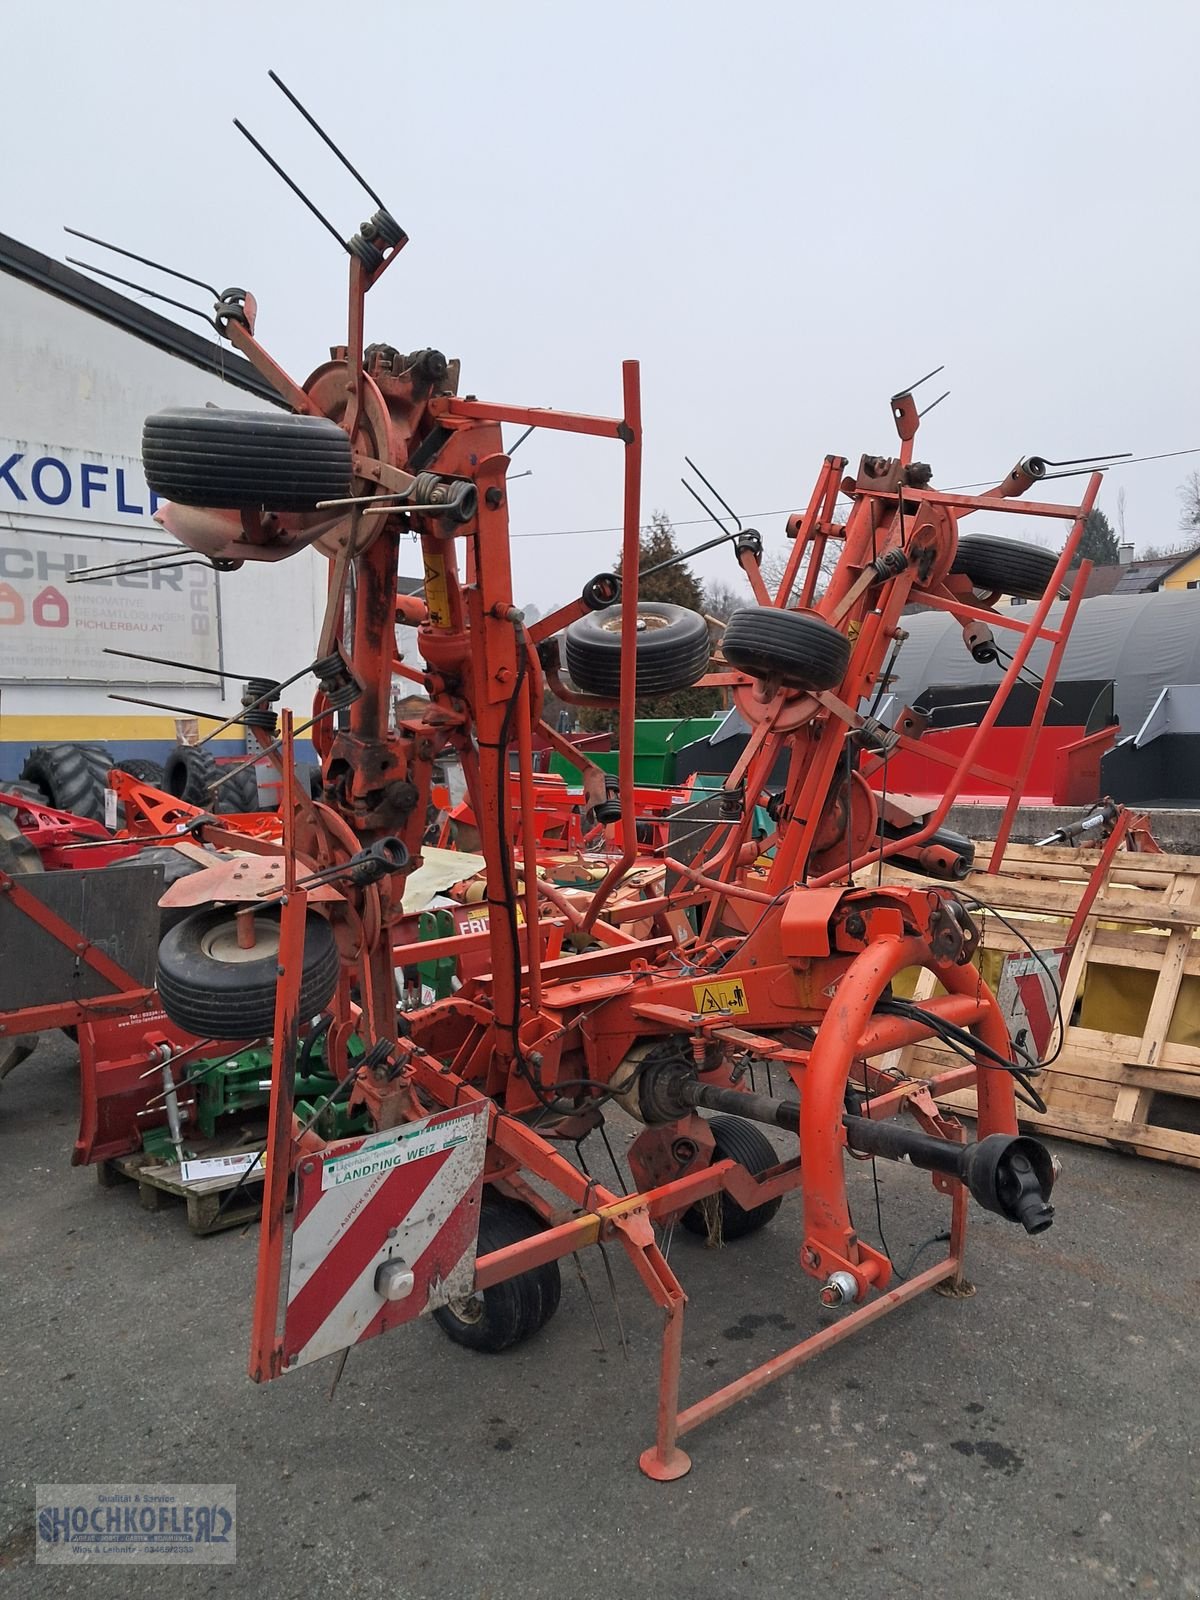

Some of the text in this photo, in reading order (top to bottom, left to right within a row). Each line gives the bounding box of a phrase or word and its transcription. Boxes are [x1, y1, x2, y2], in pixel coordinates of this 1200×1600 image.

[74, 594, 145, 608] INNOVATIVE
[75, 620, 165, 633] PICHLERBAU.AT
[407, 1143, 436, 1160] WEIZ
